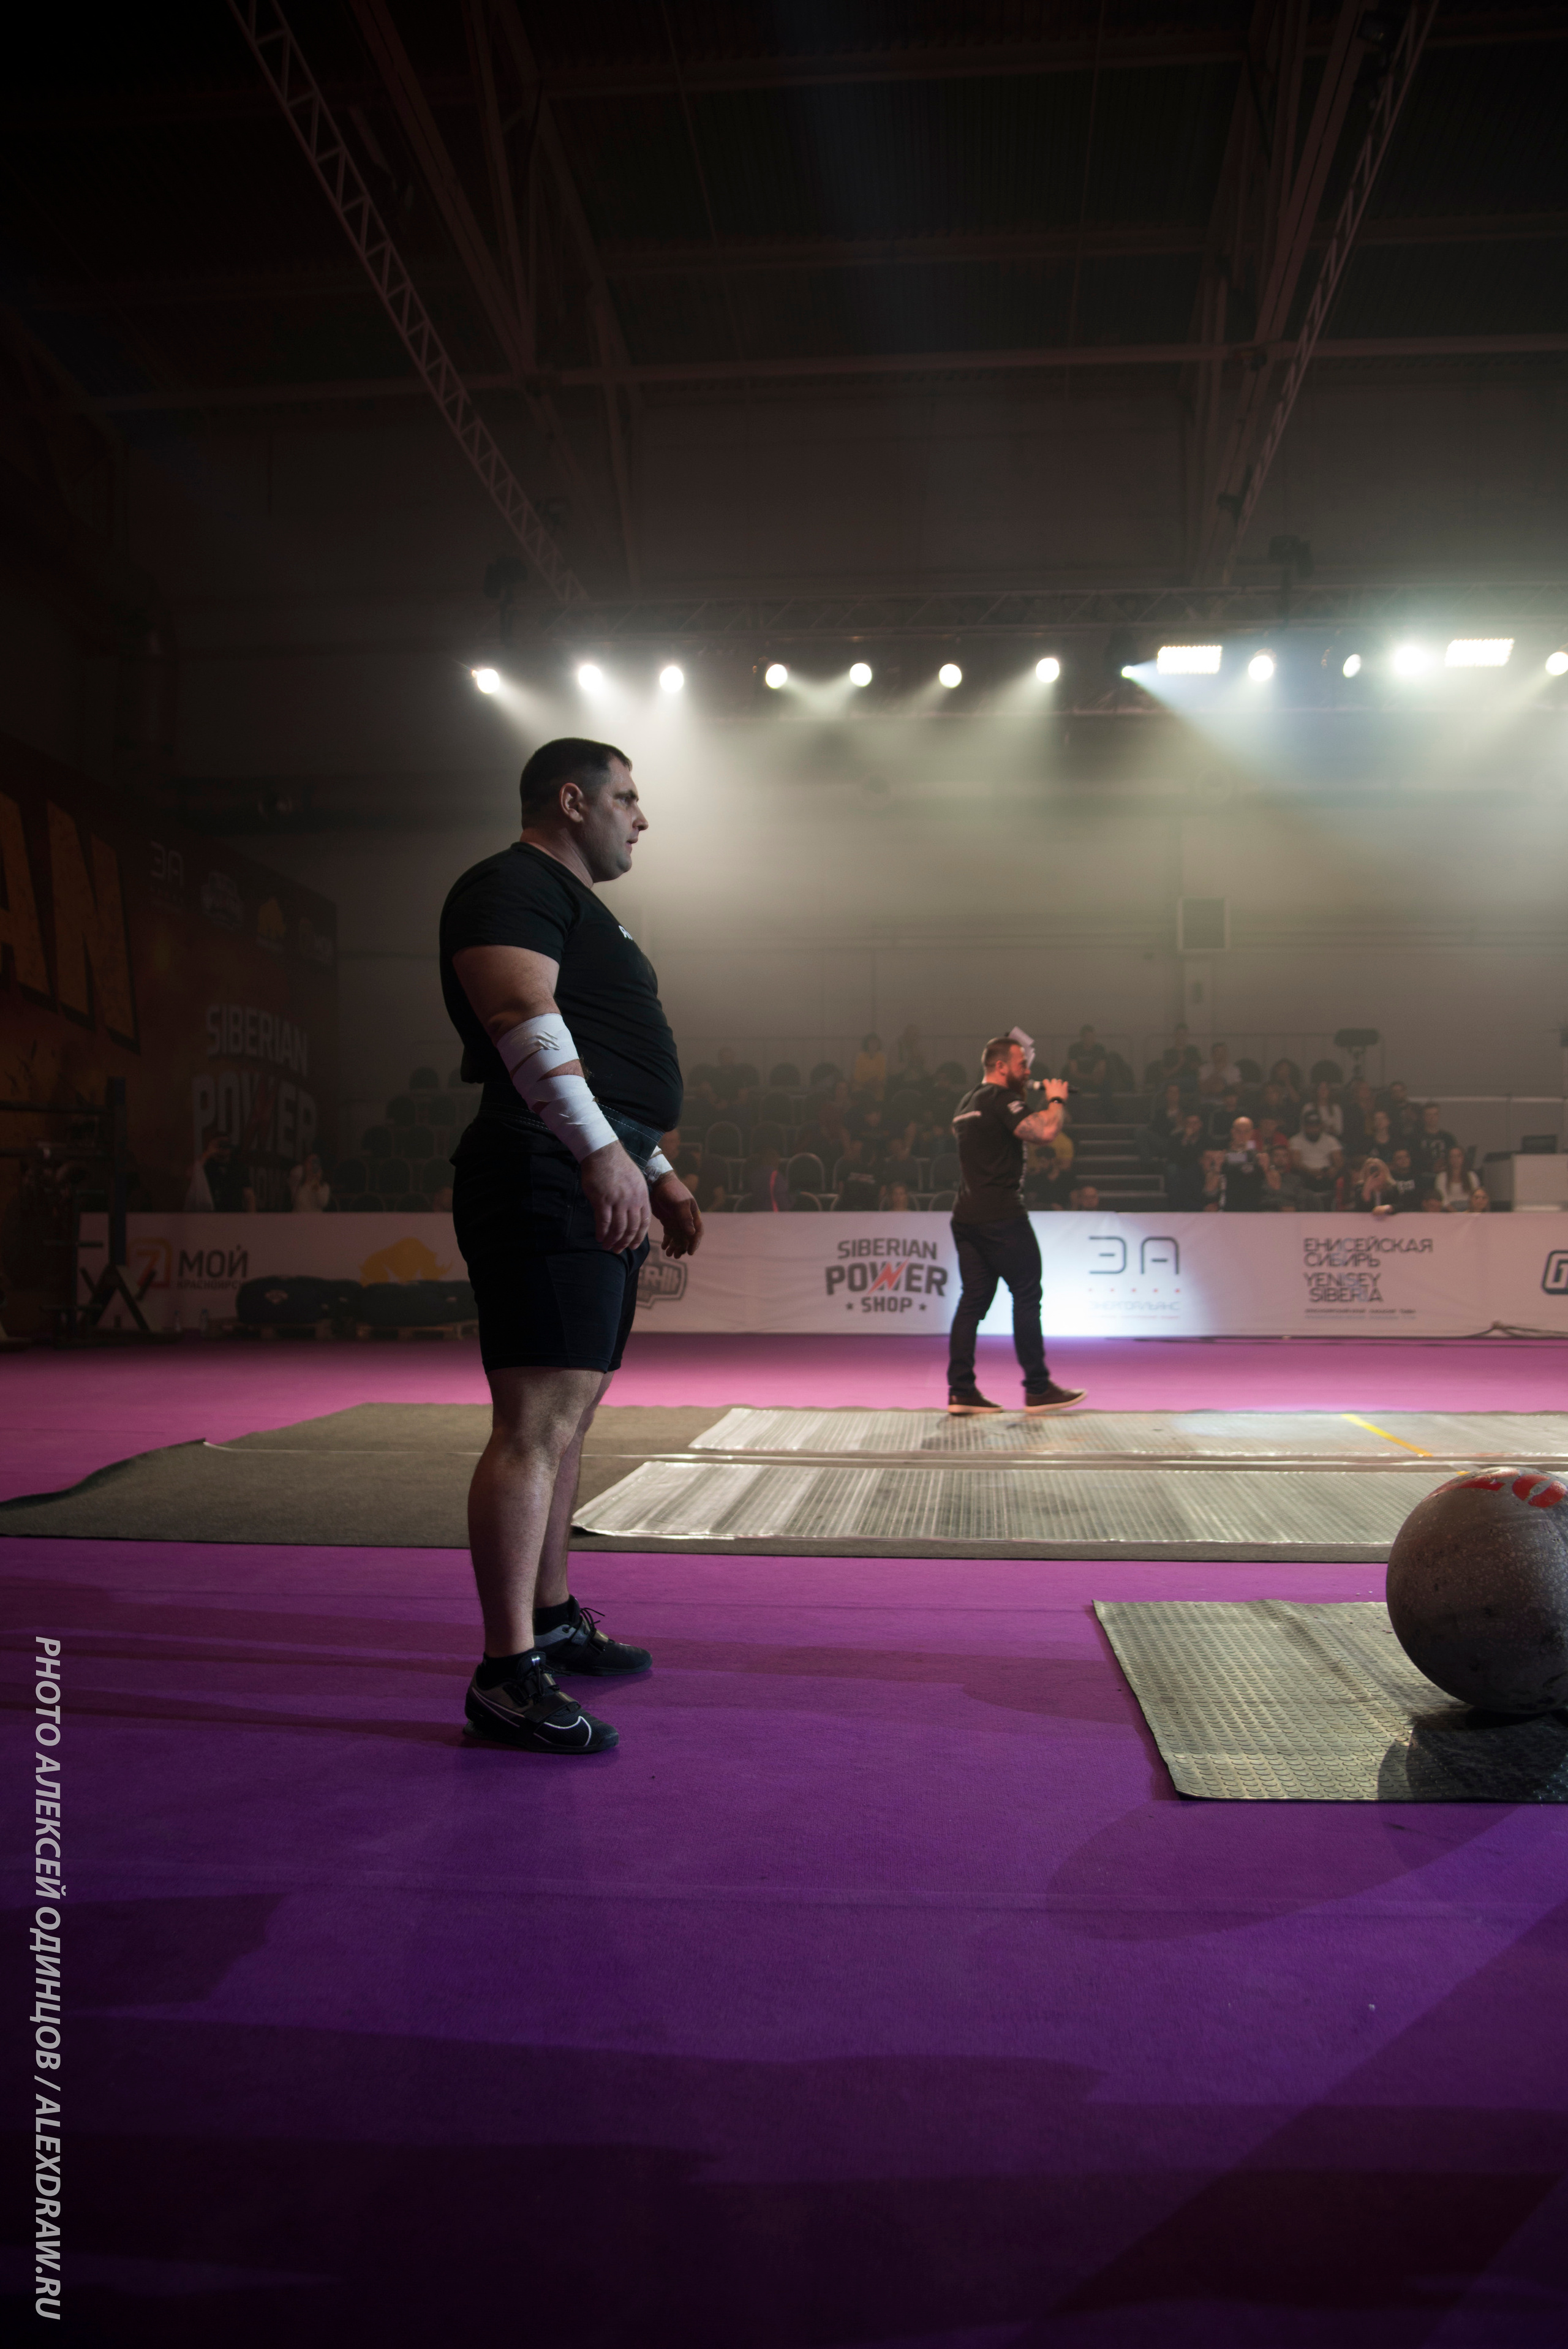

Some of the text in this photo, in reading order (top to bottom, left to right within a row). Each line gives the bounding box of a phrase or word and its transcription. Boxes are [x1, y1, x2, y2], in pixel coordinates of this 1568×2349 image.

[206, 1002, 309, 1078] SIBERIAN
[191, 1070, 318, 1164] POWER
[837, 1237, 938, 1261] SIBERIAN
[1303, 1235, 1434, 1253] ЕНИСЕЙСКАЯ
[178, 1244, 248, 1278] МОЙ
[1303, 1251, 1381, 1267] СИБИРЬ
[177, 1278, 243, 1289] КРАСНОЯРС
[825, 1259, 949, 1297] POWER
[1302, 1272, 1382, 1287] YENISEY
[1308, 1286, 1384, 1303] SIBERIA
[861, 1296, 913, 1313] SHOP
